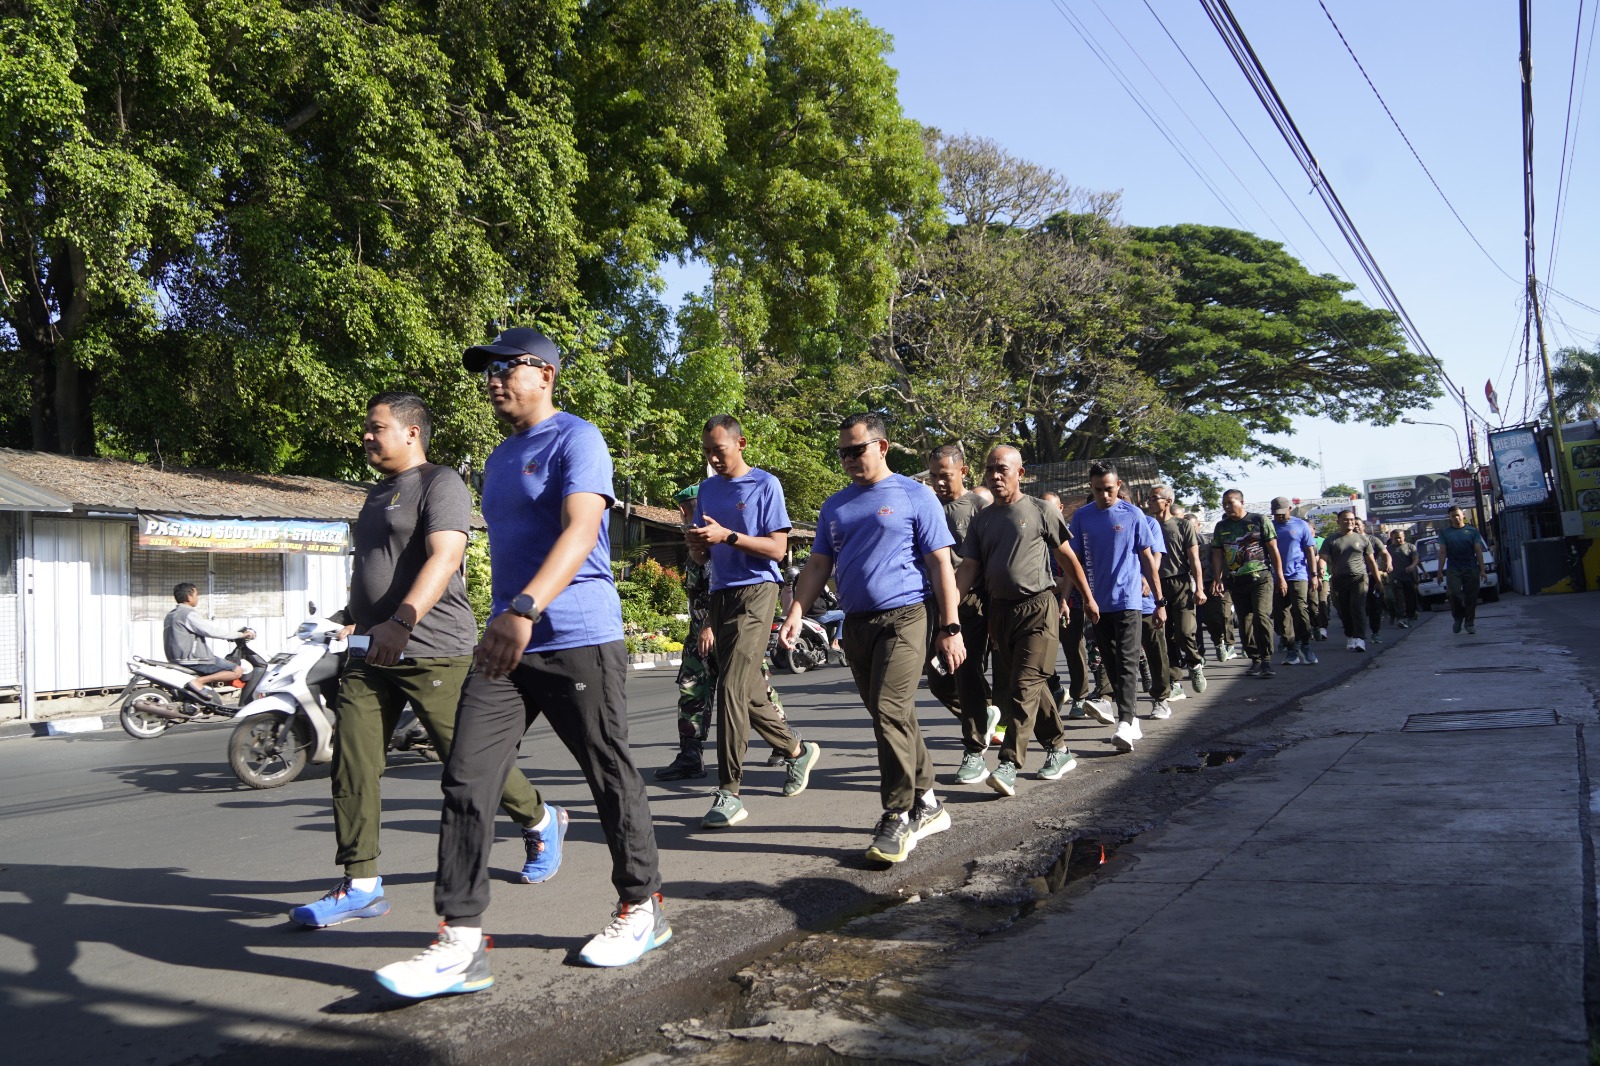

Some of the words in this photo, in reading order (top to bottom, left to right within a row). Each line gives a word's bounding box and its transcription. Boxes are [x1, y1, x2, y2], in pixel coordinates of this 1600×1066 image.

[1492, 437, 1511, 451] MIE
[1511, 433, 1533, 447] BASO
[1374, 491, 1411, 500] ESPRESSO
[144, 520, 212, 538] PASANG
[292, 528, 343, 543] STICKER
